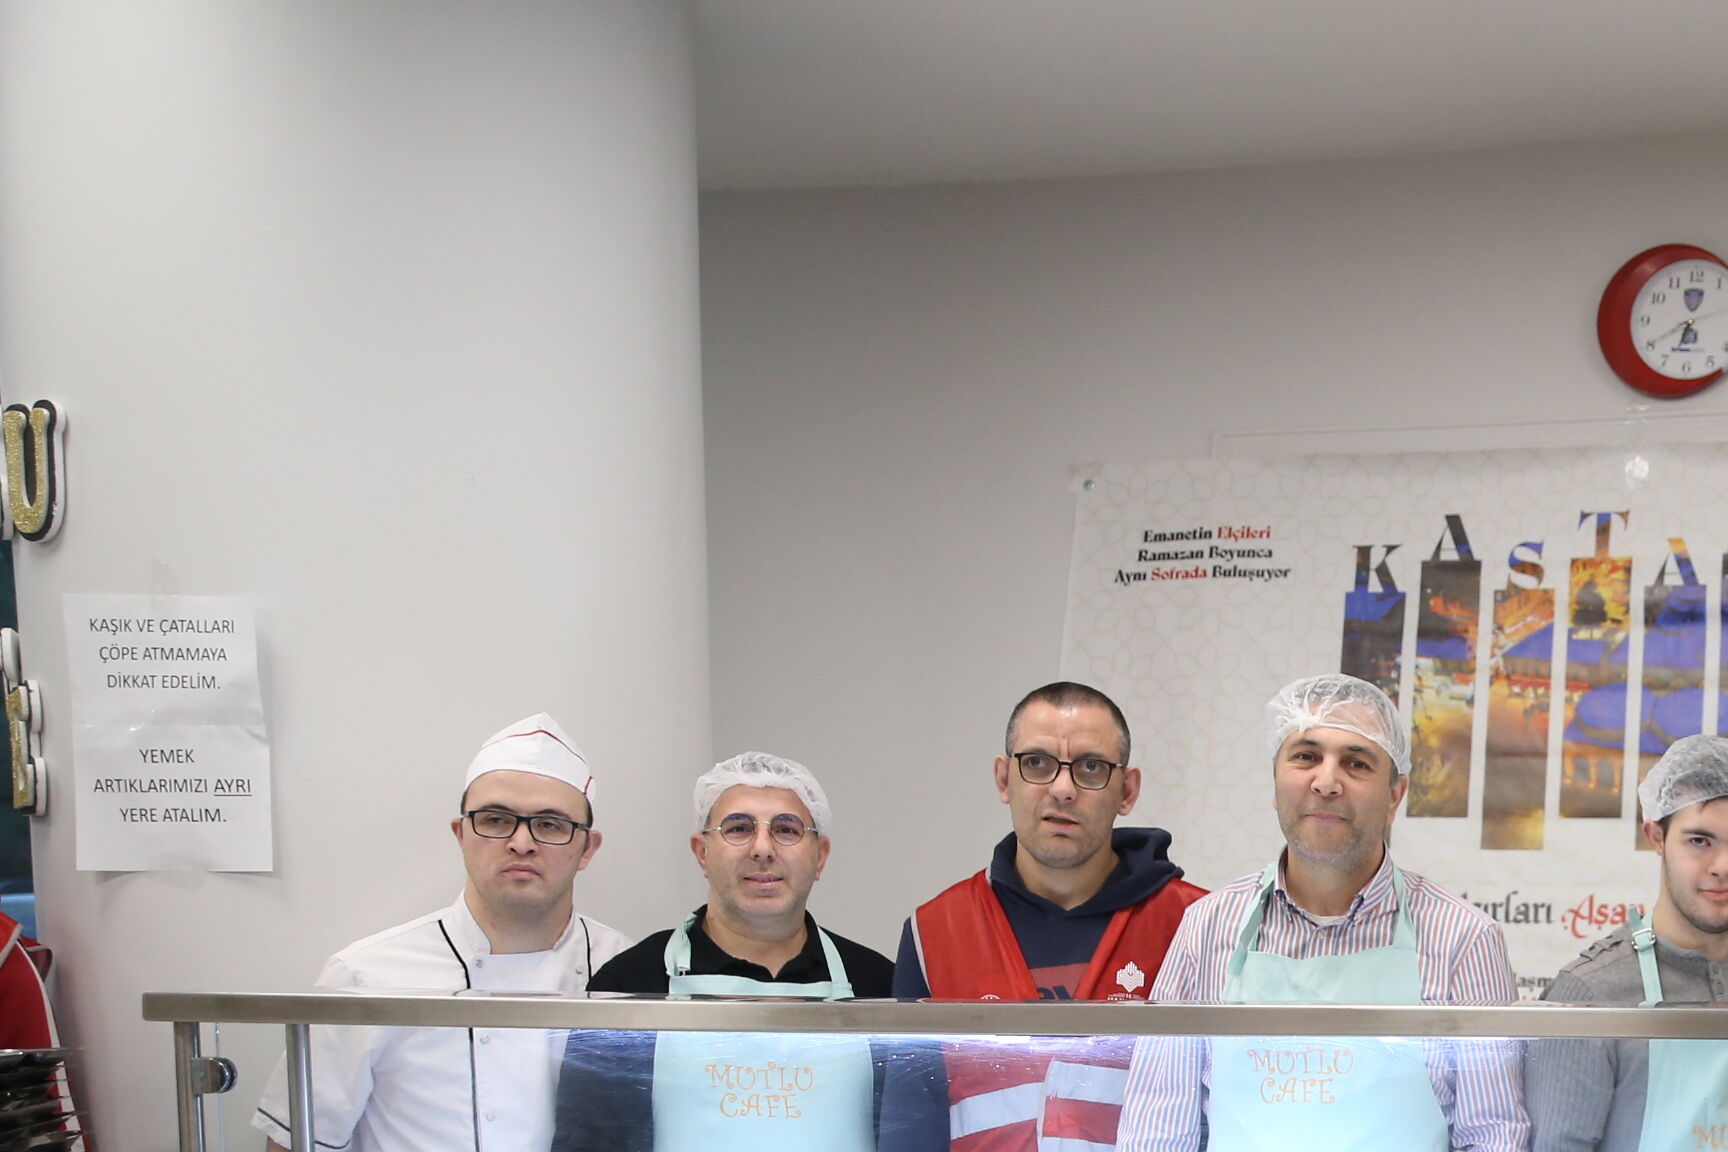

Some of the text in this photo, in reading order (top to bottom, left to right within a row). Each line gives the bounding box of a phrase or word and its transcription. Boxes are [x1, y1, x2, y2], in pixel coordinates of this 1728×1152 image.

[1669, 277, 1681, 289] 11
[1690, 270, 1704, 283] 12
[1651, 292, 1666, 304] 10
[1640, 316, 1650, 327] 9
[1646, 340, 1656, 350] 8
[1661, 355, 1669, 367] 7
[1682, 362, 1691, 372] 6
[1706, 355, 1715, 367] 5
[1143, 525, 1272, 543] Emanetin Elçileri
[1137, 546, 1273, 562] Ramazan Boyunca
[1114, 565, 1291, 586] Aynı Sofrada Buluşuyor
[89, 617, 235, 636] KAŞIK VE ÇATALLARI
[99, 643, 228, 663] ÇÖPE ATMAMAYA
[106, 671, 222, 690] DİKKAT EDELİM.
[139, 749, 195, 764] YEMEK
[93, 778, 252, 796] ARTIKLARIMIZI AYRI
[119, 808, 227, 823] YERE ATALIM.
[1247, 1044, 1354, 1075] MUTLU
[704, 1061, 813, 1091] MUTLU
[1260, 1077, 1336, 1104] CAFE
[719, 1093, 801, 1118] CAFE
